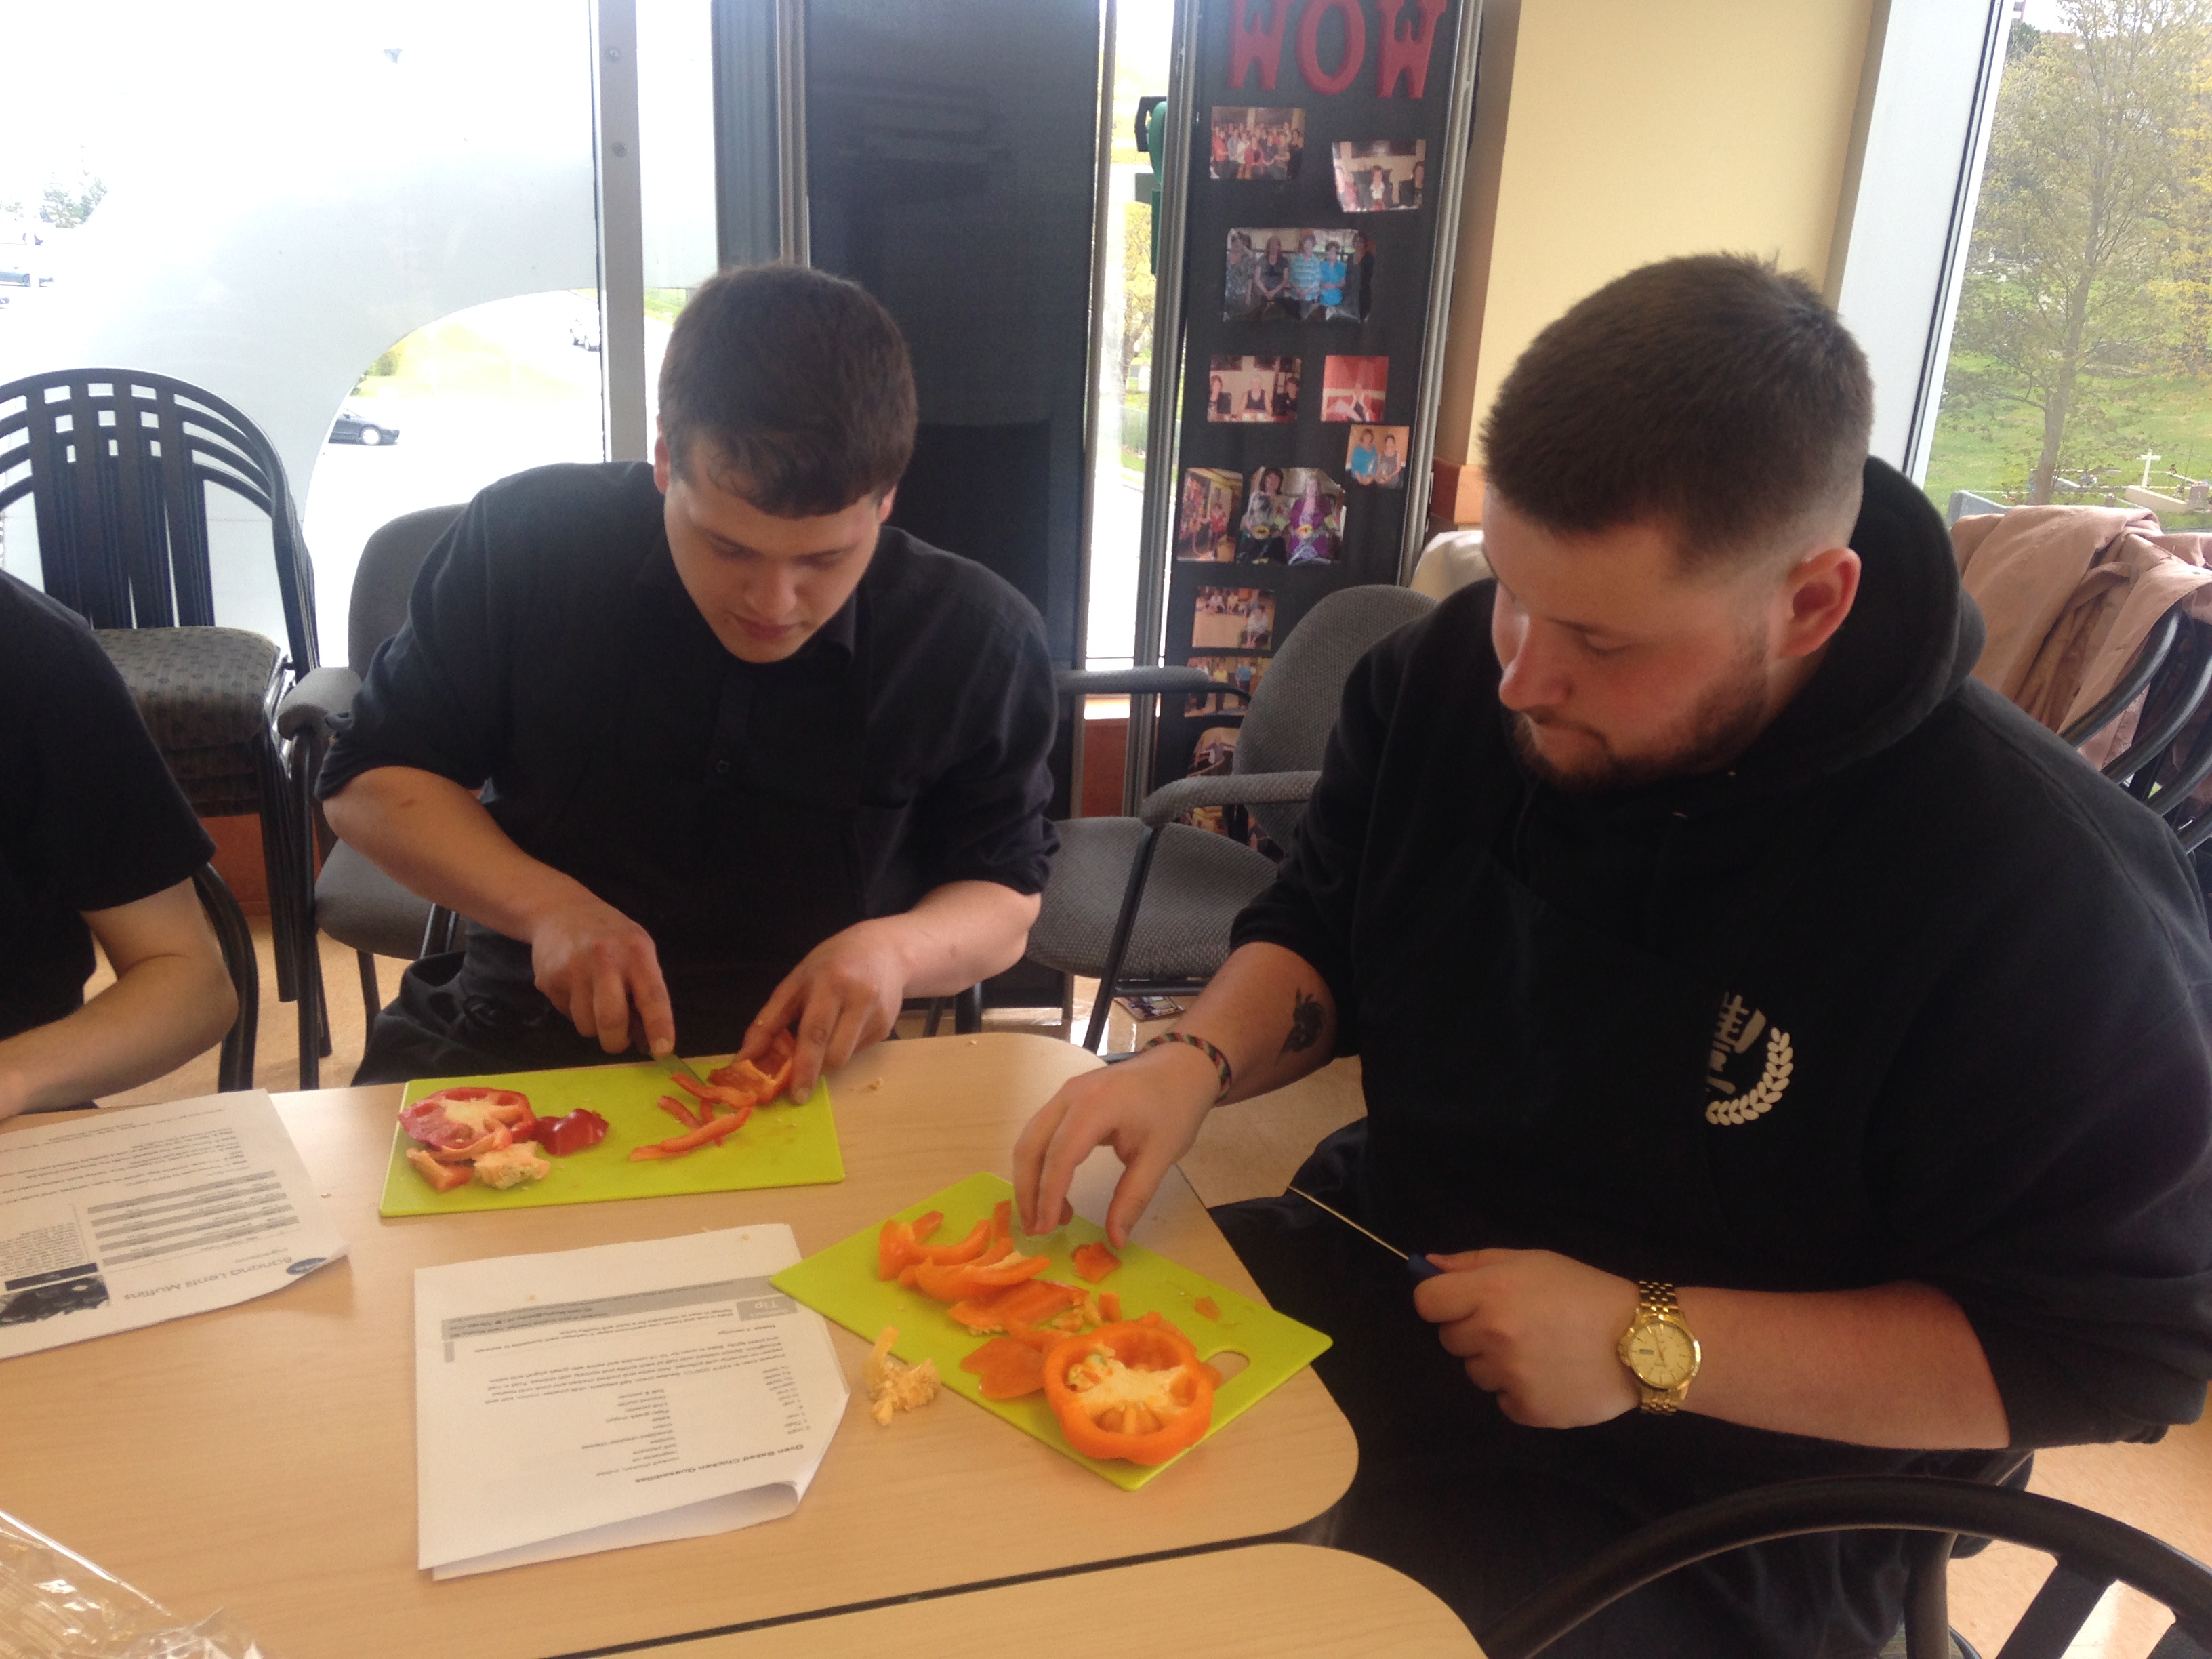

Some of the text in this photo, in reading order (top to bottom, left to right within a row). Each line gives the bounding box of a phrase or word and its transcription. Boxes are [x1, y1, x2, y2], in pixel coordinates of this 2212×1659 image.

[1227, 0, 1448, 100] WOW
[230, 1256, 292, 1275] Banana
[184, 1273, 226, 1288] Lentil
[123, 1283, 181, 1302] Muffins
[754, 1299, 778, 1311] Tip
[742, 1450, 775, 1461] Baked
[777, 1443, 804, 1454] Oven
[698, 1458, 740, 1471] Chicken
